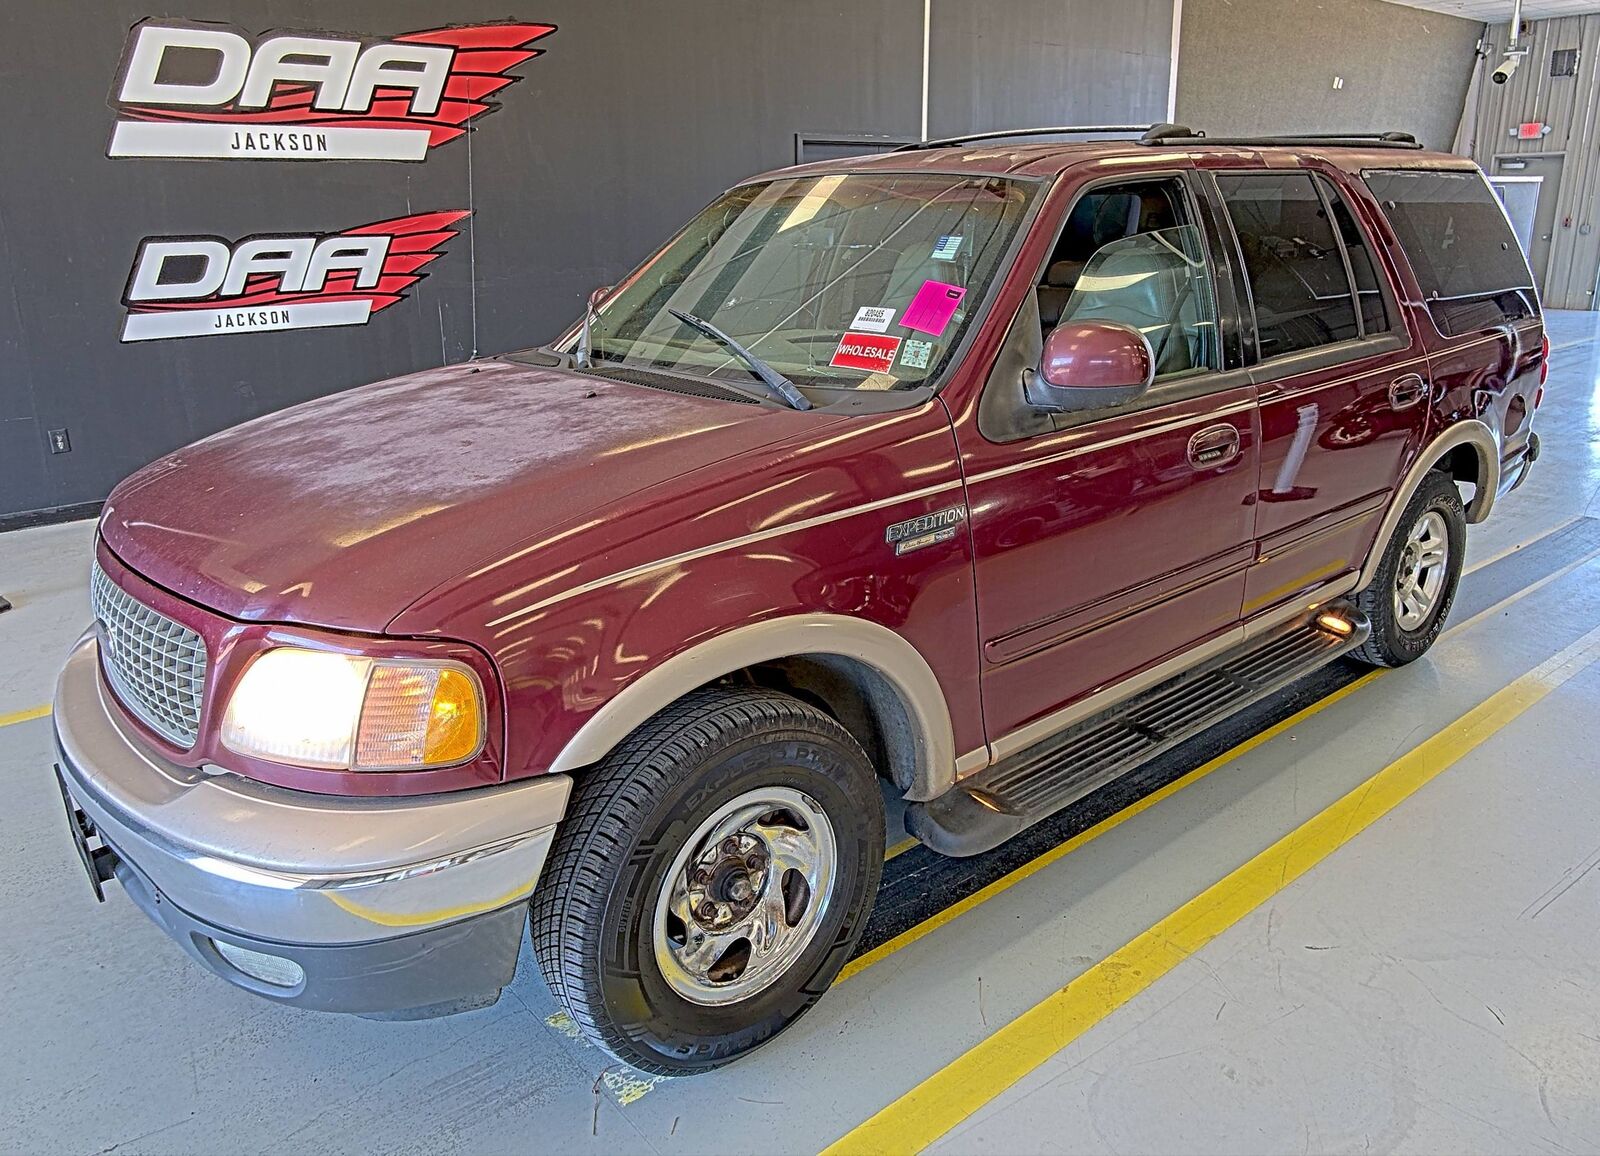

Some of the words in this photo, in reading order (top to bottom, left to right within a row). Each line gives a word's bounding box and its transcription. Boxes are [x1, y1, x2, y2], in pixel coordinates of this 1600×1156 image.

[120, 26, 455, 113] DAA
[231, 132, 328, 152] JACKSON
[130, 236, 391, 301] DAA
[214, 310, 290, 329] JACKSON
[838, 344, 896, 360] WHOLESALE
[888, 505, 965, 541] EXPEDITION
